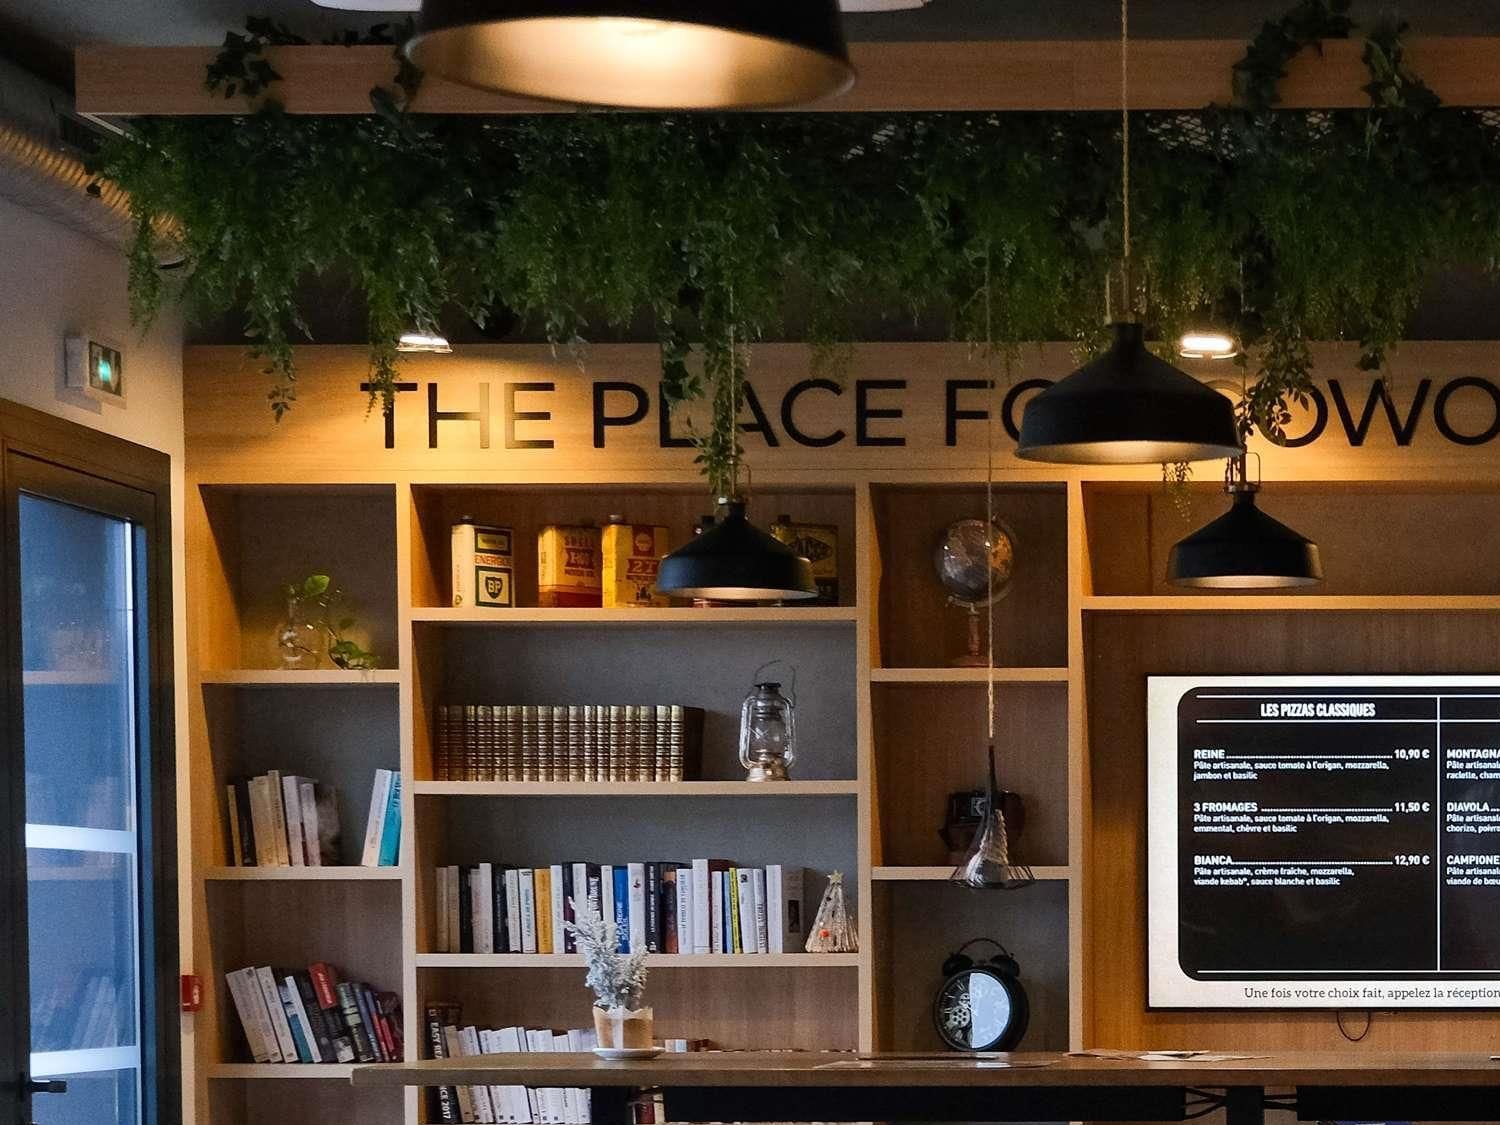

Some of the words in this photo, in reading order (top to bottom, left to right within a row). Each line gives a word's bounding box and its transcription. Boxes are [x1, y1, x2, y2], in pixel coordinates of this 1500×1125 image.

[360, 382, 553, 450] THE
[486, 580, 502, 594] BP
[1261, 704, 1279, 717] LES
[1281, 704, 1315, 717] PIZZAS
[1317, 703, 1376, 717] CLASSIQUES
[1194, 750, 1225, 759] REINE
[1394, 749, 1420, 760] 10,90
[1422, 749, 1430, 759] €
[1194, 761, 1211, 770] Pâte
[1213, 761, 1253, 770] artisanale,
[1306, 761, 1312, 769] à
[1345, 761, 1389, 770] mozzarella,
[1194, 772, 1222, 781] jambon
[1224, 772, 1231, 780] et
[1447, 771, 1478, 780] raclette,
[1194, 803, 1200, 812] 3
[1203, 802, 1258, 812] FROMAGES
[1395, 802, 1420, 813] 11,50
[1422, 802, 1430, 812] €
[1447, 802, 1489, 812] DIAVOLA
[1194, 814, 1211, 822] Pâte
[1213, 814, 1253, 823] artisanale,
[1307, 814, 1312, 822] à
[1346, 814, 1389, 823] mozzarella,
[1447, 814, 1464, 822] Pâte
[1194, 825, 1235, 833] emmental,
[1236, 824, 1261, 832] chèvre
[1272, 824, 1297, 832] basilic
[1446, 824, 1477, 833] chorizo,
[1194, 856, 1232, 865] BIANCA
[1395, 855, 1420, 866] 12,90
[1422, 855, 1430, 865] €
[1447, 855, 1500, 865] CAMPIONE
[1194, 867, 1211, 875] Pâte
[1214, 868, 1253, 876] artisanale,
[1255, 867, 1279, 875] crème
[1311, 868, 1355, 876] mozzarella,
[1447, 867, 1464, 875] Pâte
[1446, 877, 1471, 885] viande
[1244, 988, 1268, 998] Une
[1271, 988, 1292, 998] fois
[1295, 990, 1325, 998] votre
[1328, 988, 1360, 998] choix
[1363, 988, 1384, 999] fait,
[1388, 988, 1431, 1000] appelez
[1434, 988, 1444, 998] la
[441, 1102, 451, 1120] 2017
